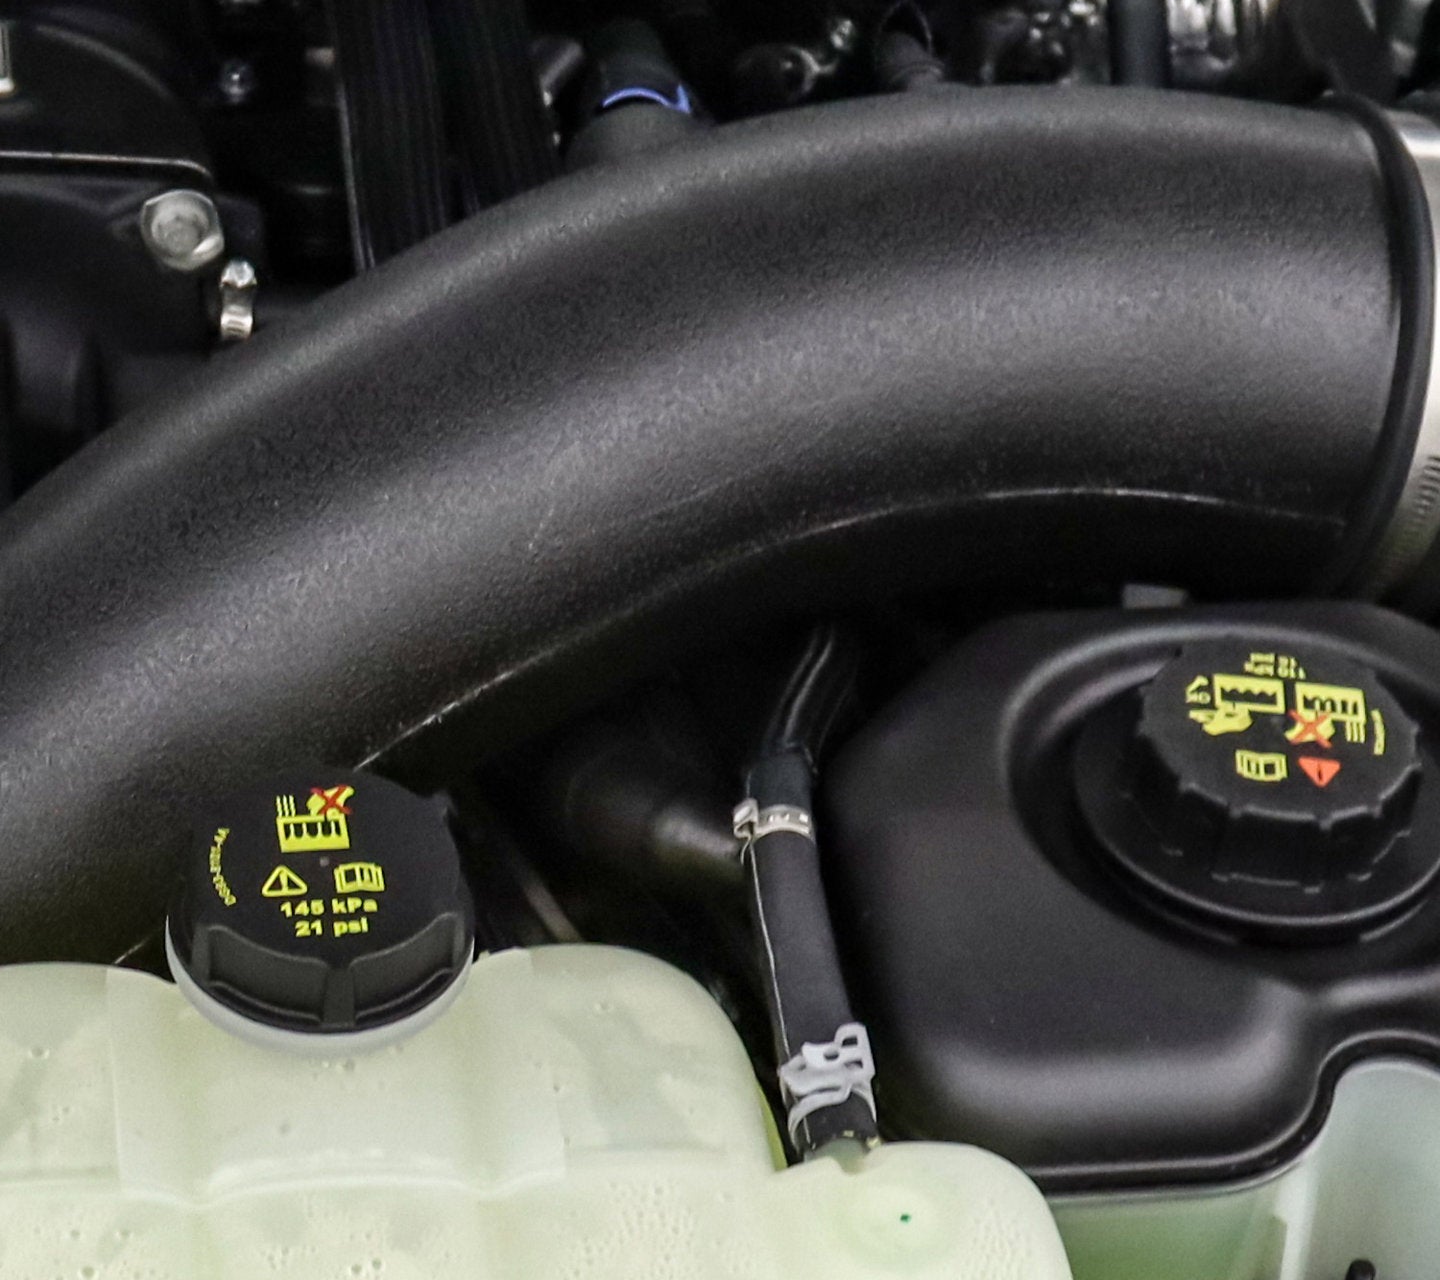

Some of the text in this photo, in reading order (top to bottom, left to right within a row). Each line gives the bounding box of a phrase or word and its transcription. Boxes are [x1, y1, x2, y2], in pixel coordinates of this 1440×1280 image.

[280, 897, 378, 918] 145 kPa
[295, 916, 369, 937] 21 psi
